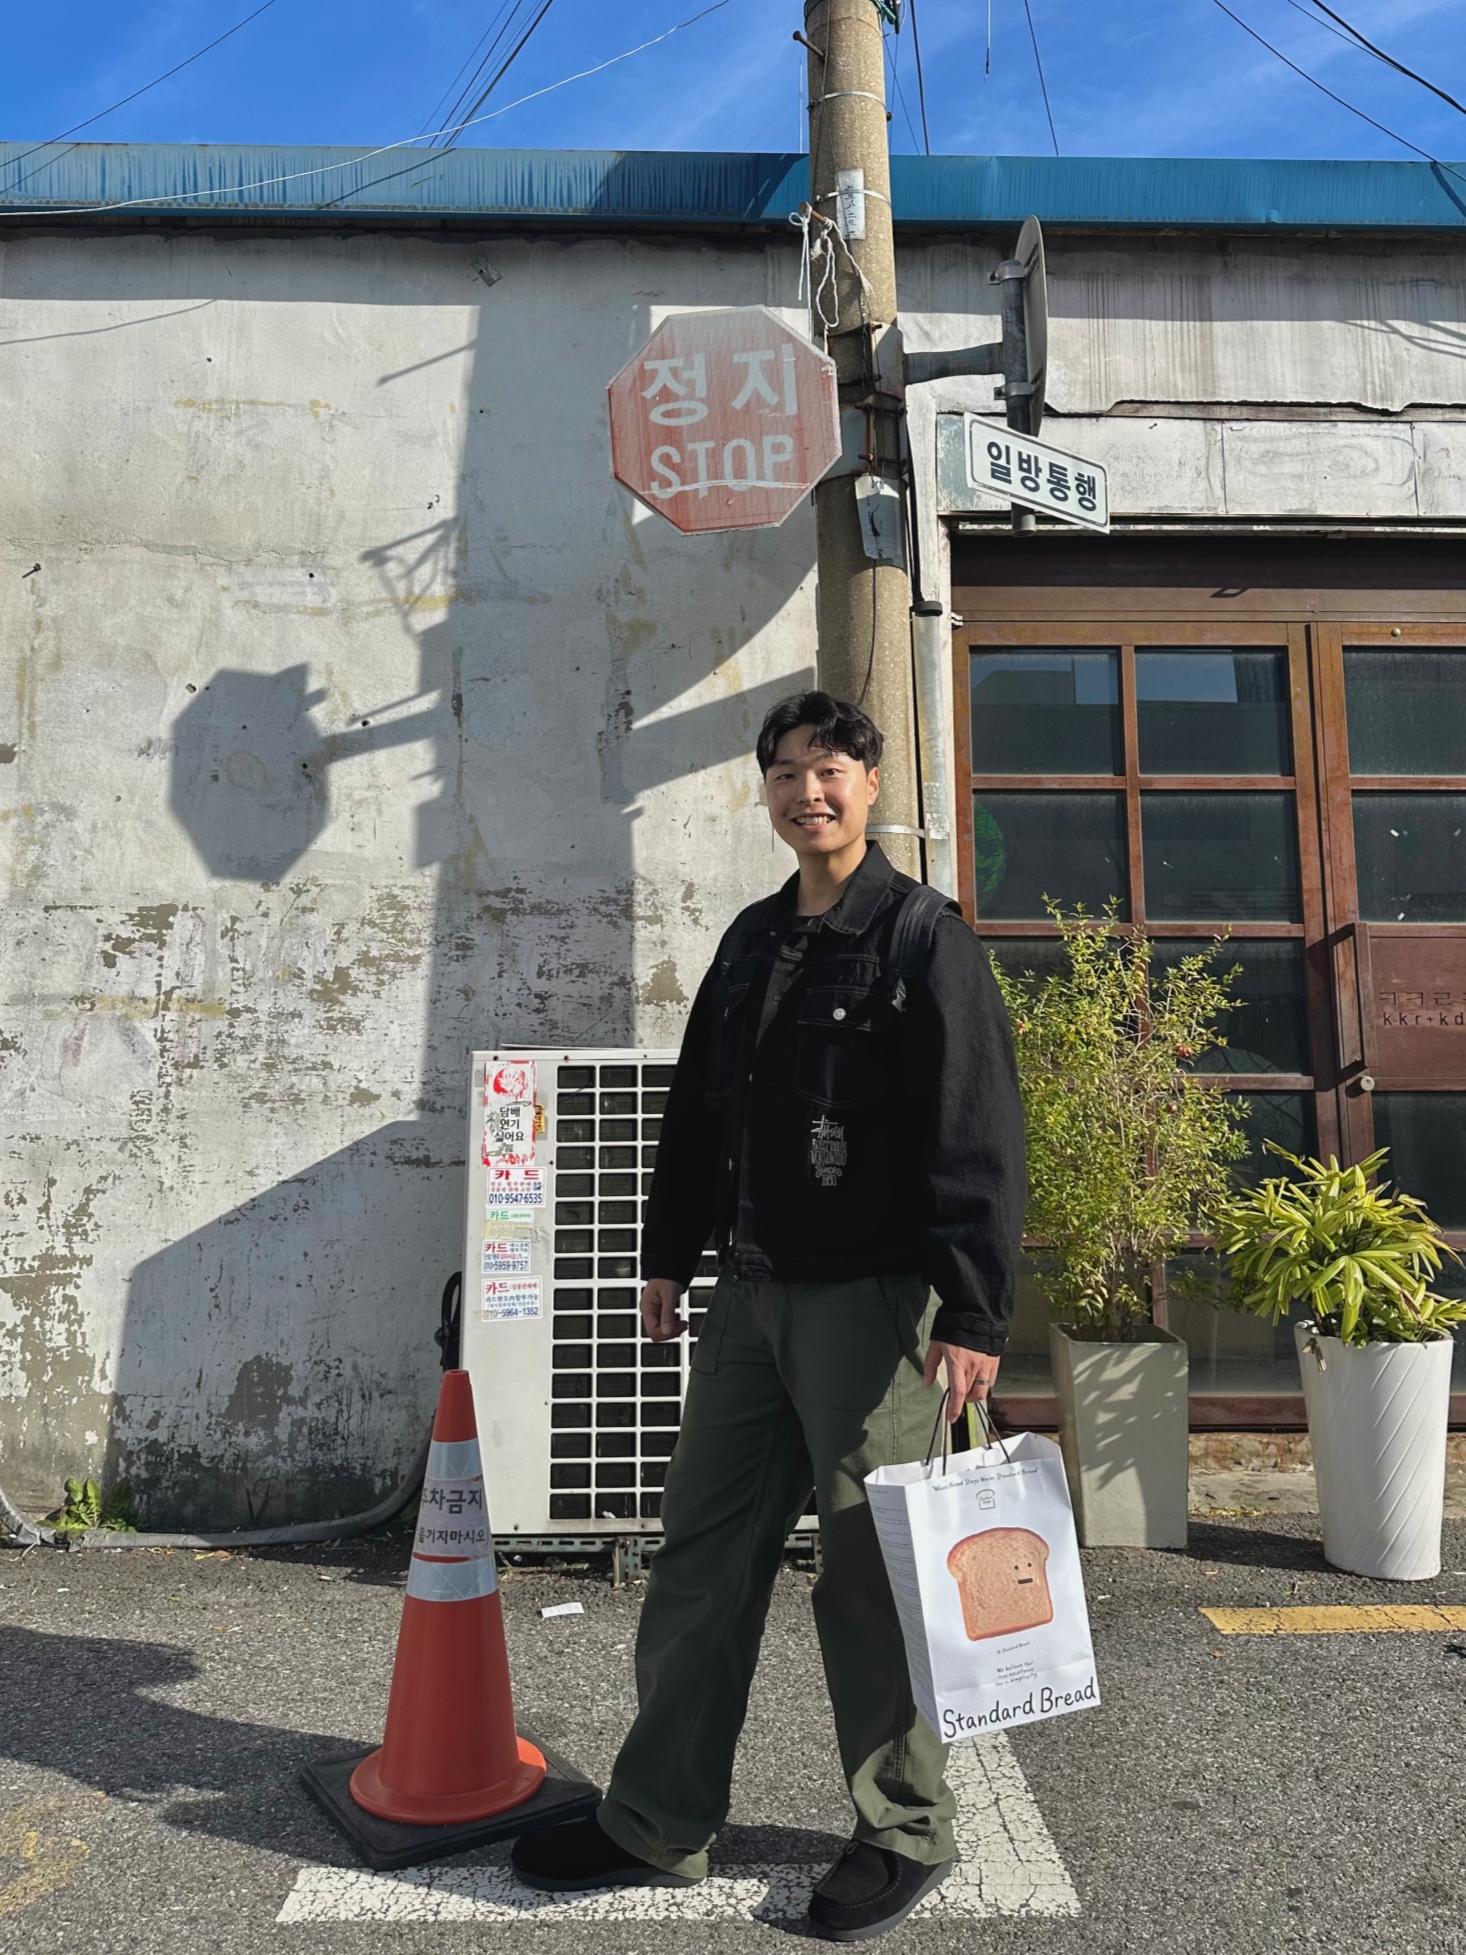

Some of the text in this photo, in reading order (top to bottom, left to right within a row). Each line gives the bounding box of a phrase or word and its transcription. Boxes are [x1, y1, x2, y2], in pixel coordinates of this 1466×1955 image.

[641, 342, 798, 426] 정지
[650, 434, 794, 499] STOP
[986, 441, 1097, 512] 일방통행
[500, 1106, 520, 1118] 담배
[500, 1119, 519, 1130] 연기
[489, 1193, 543, 1204] 010-9547-6535
[489, 1210, 510, 1221] 카드
[485, 1242, 508, 1253] 카드
[485, 1281, 510, 1296] 카드
[943, 1692, 1035, 1738] Standard
[1040, 1676, 1097, 1713] Bread
